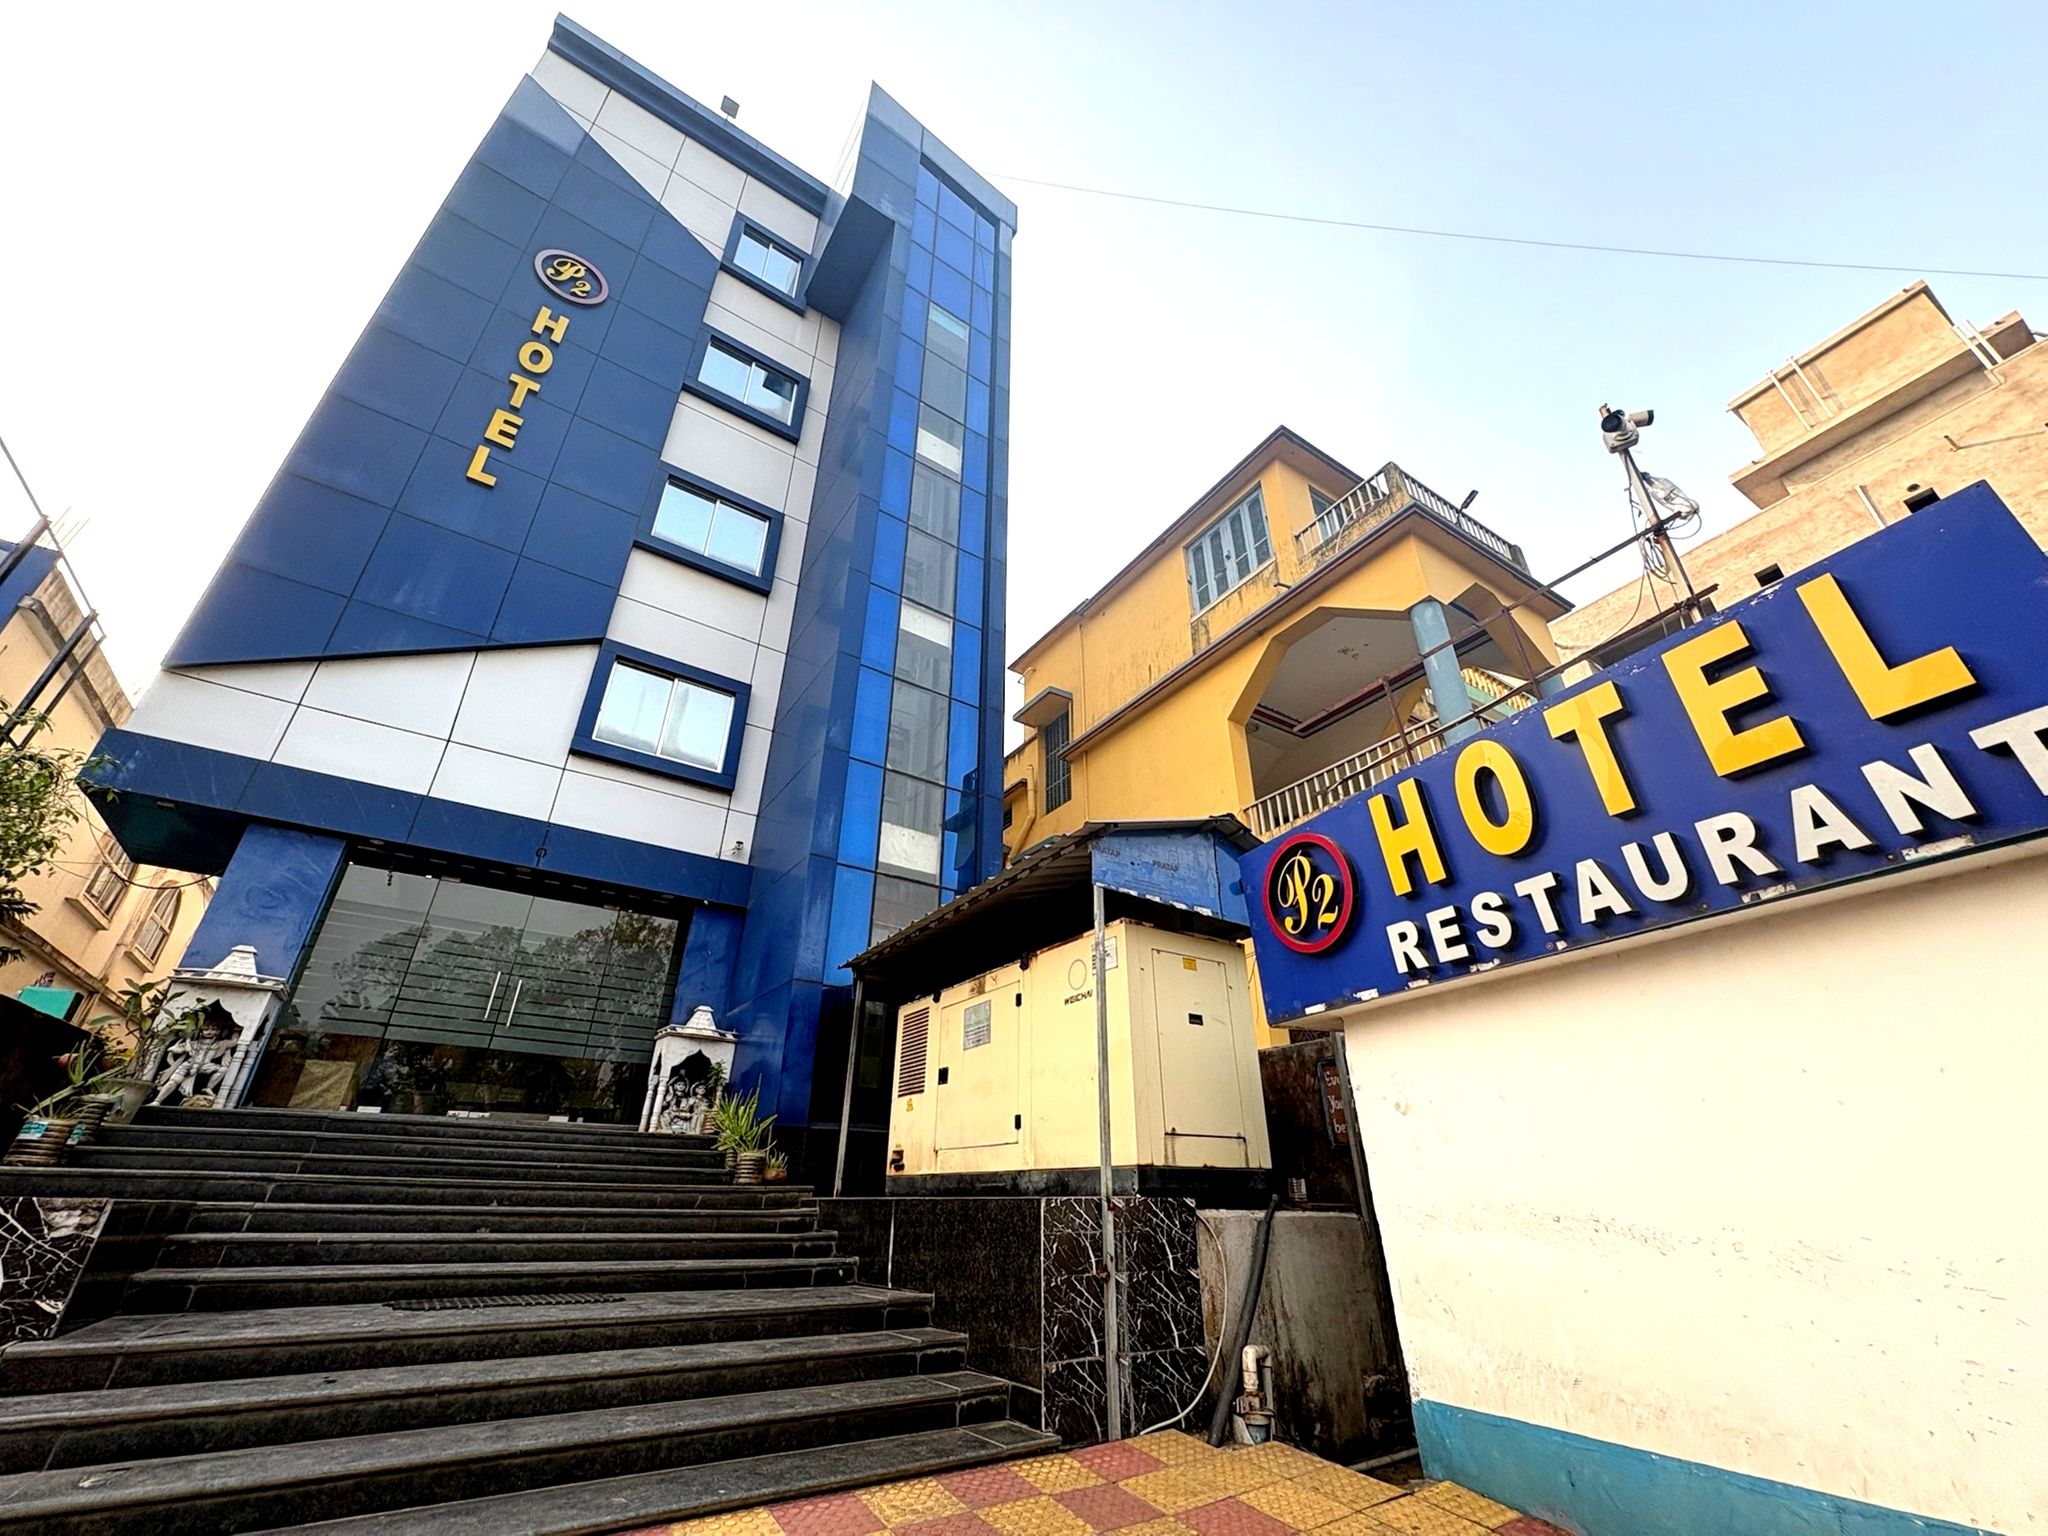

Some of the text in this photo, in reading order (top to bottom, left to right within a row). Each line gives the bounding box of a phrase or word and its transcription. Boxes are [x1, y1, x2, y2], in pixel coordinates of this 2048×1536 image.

[546, 258, 592, 297] P2
[465, 305, 570, 488] HOTEL
[1366, 572, 1977, 897] HOTEL
[1277, 849, 1339, 935] P2
[1385, 704, 2048, 975] RESTAURANT
